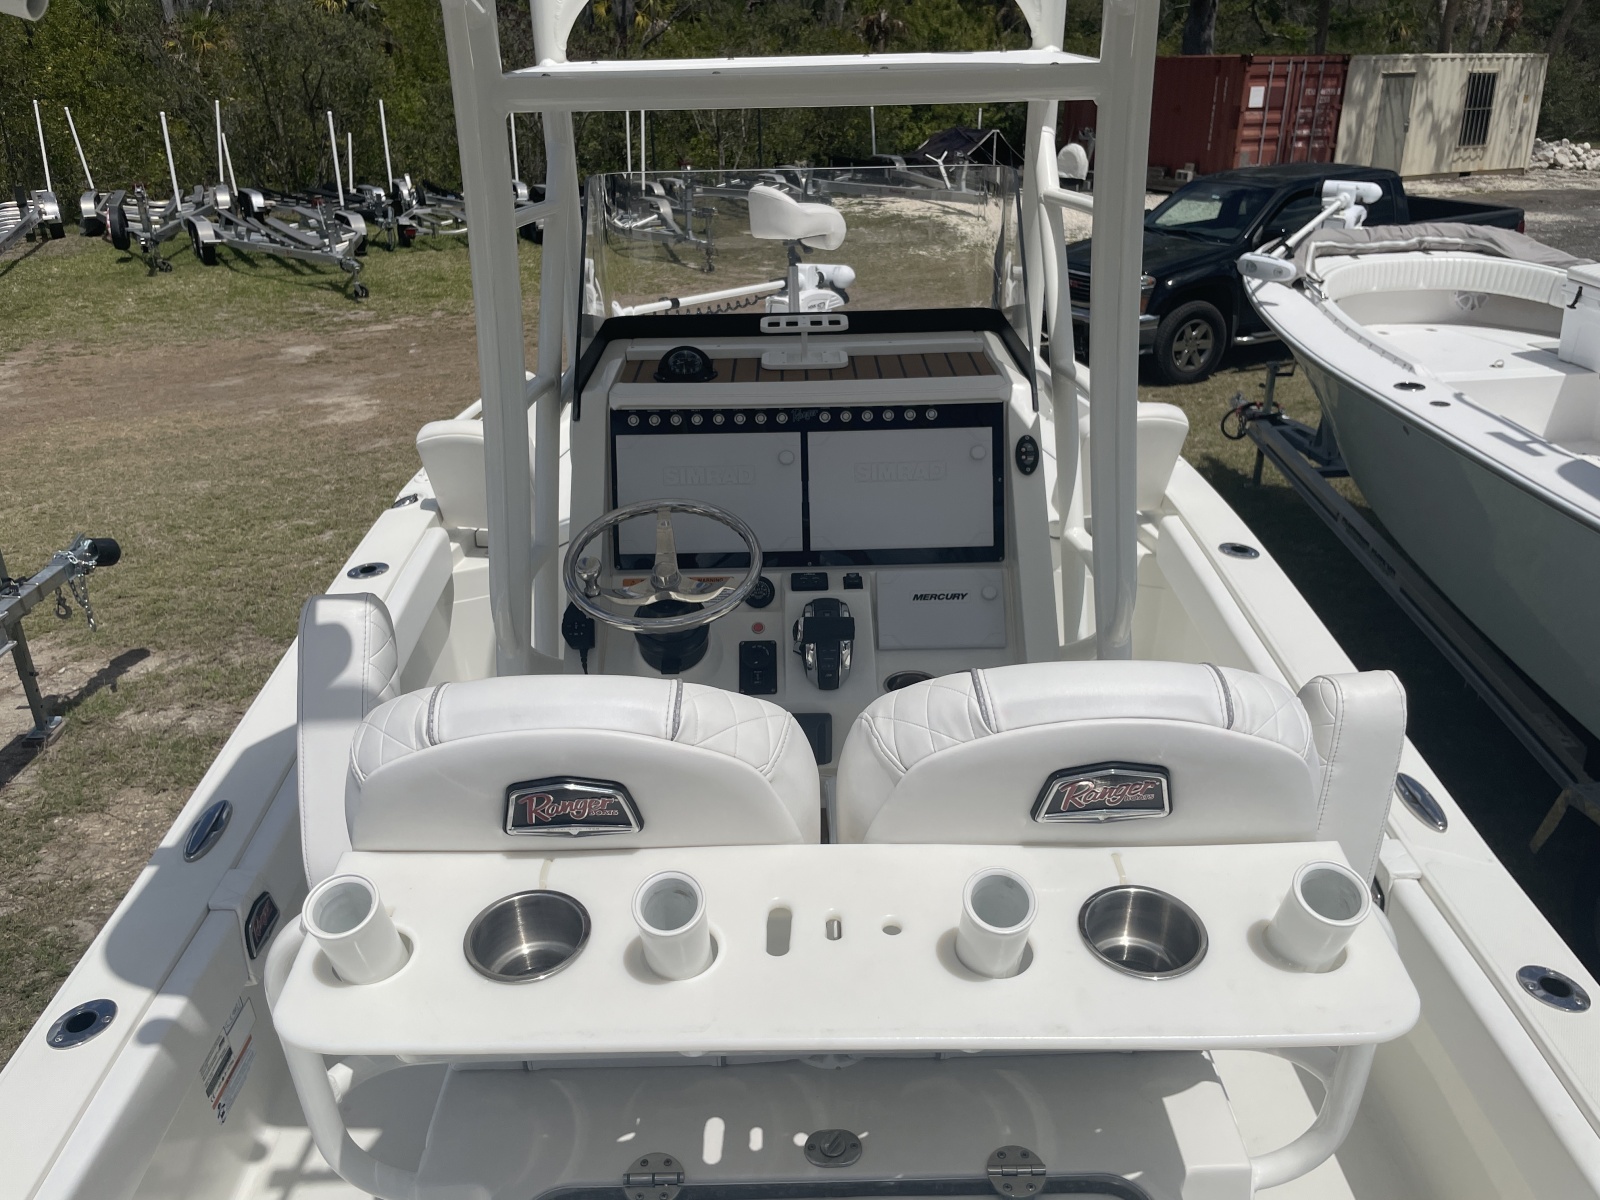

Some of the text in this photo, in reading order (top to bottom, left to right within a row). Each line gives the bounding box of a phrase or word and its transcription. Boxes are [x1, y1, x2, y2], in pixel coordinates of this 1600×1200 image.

[664, 466, 754, 485] SIMRAD
[855, 461, 946, 482] SIMRAD
[912, 592, 969, 601] MERCURY
[1058, 779, 1157, 811] Ranger
[517, 793, 615, 824] Ranger
